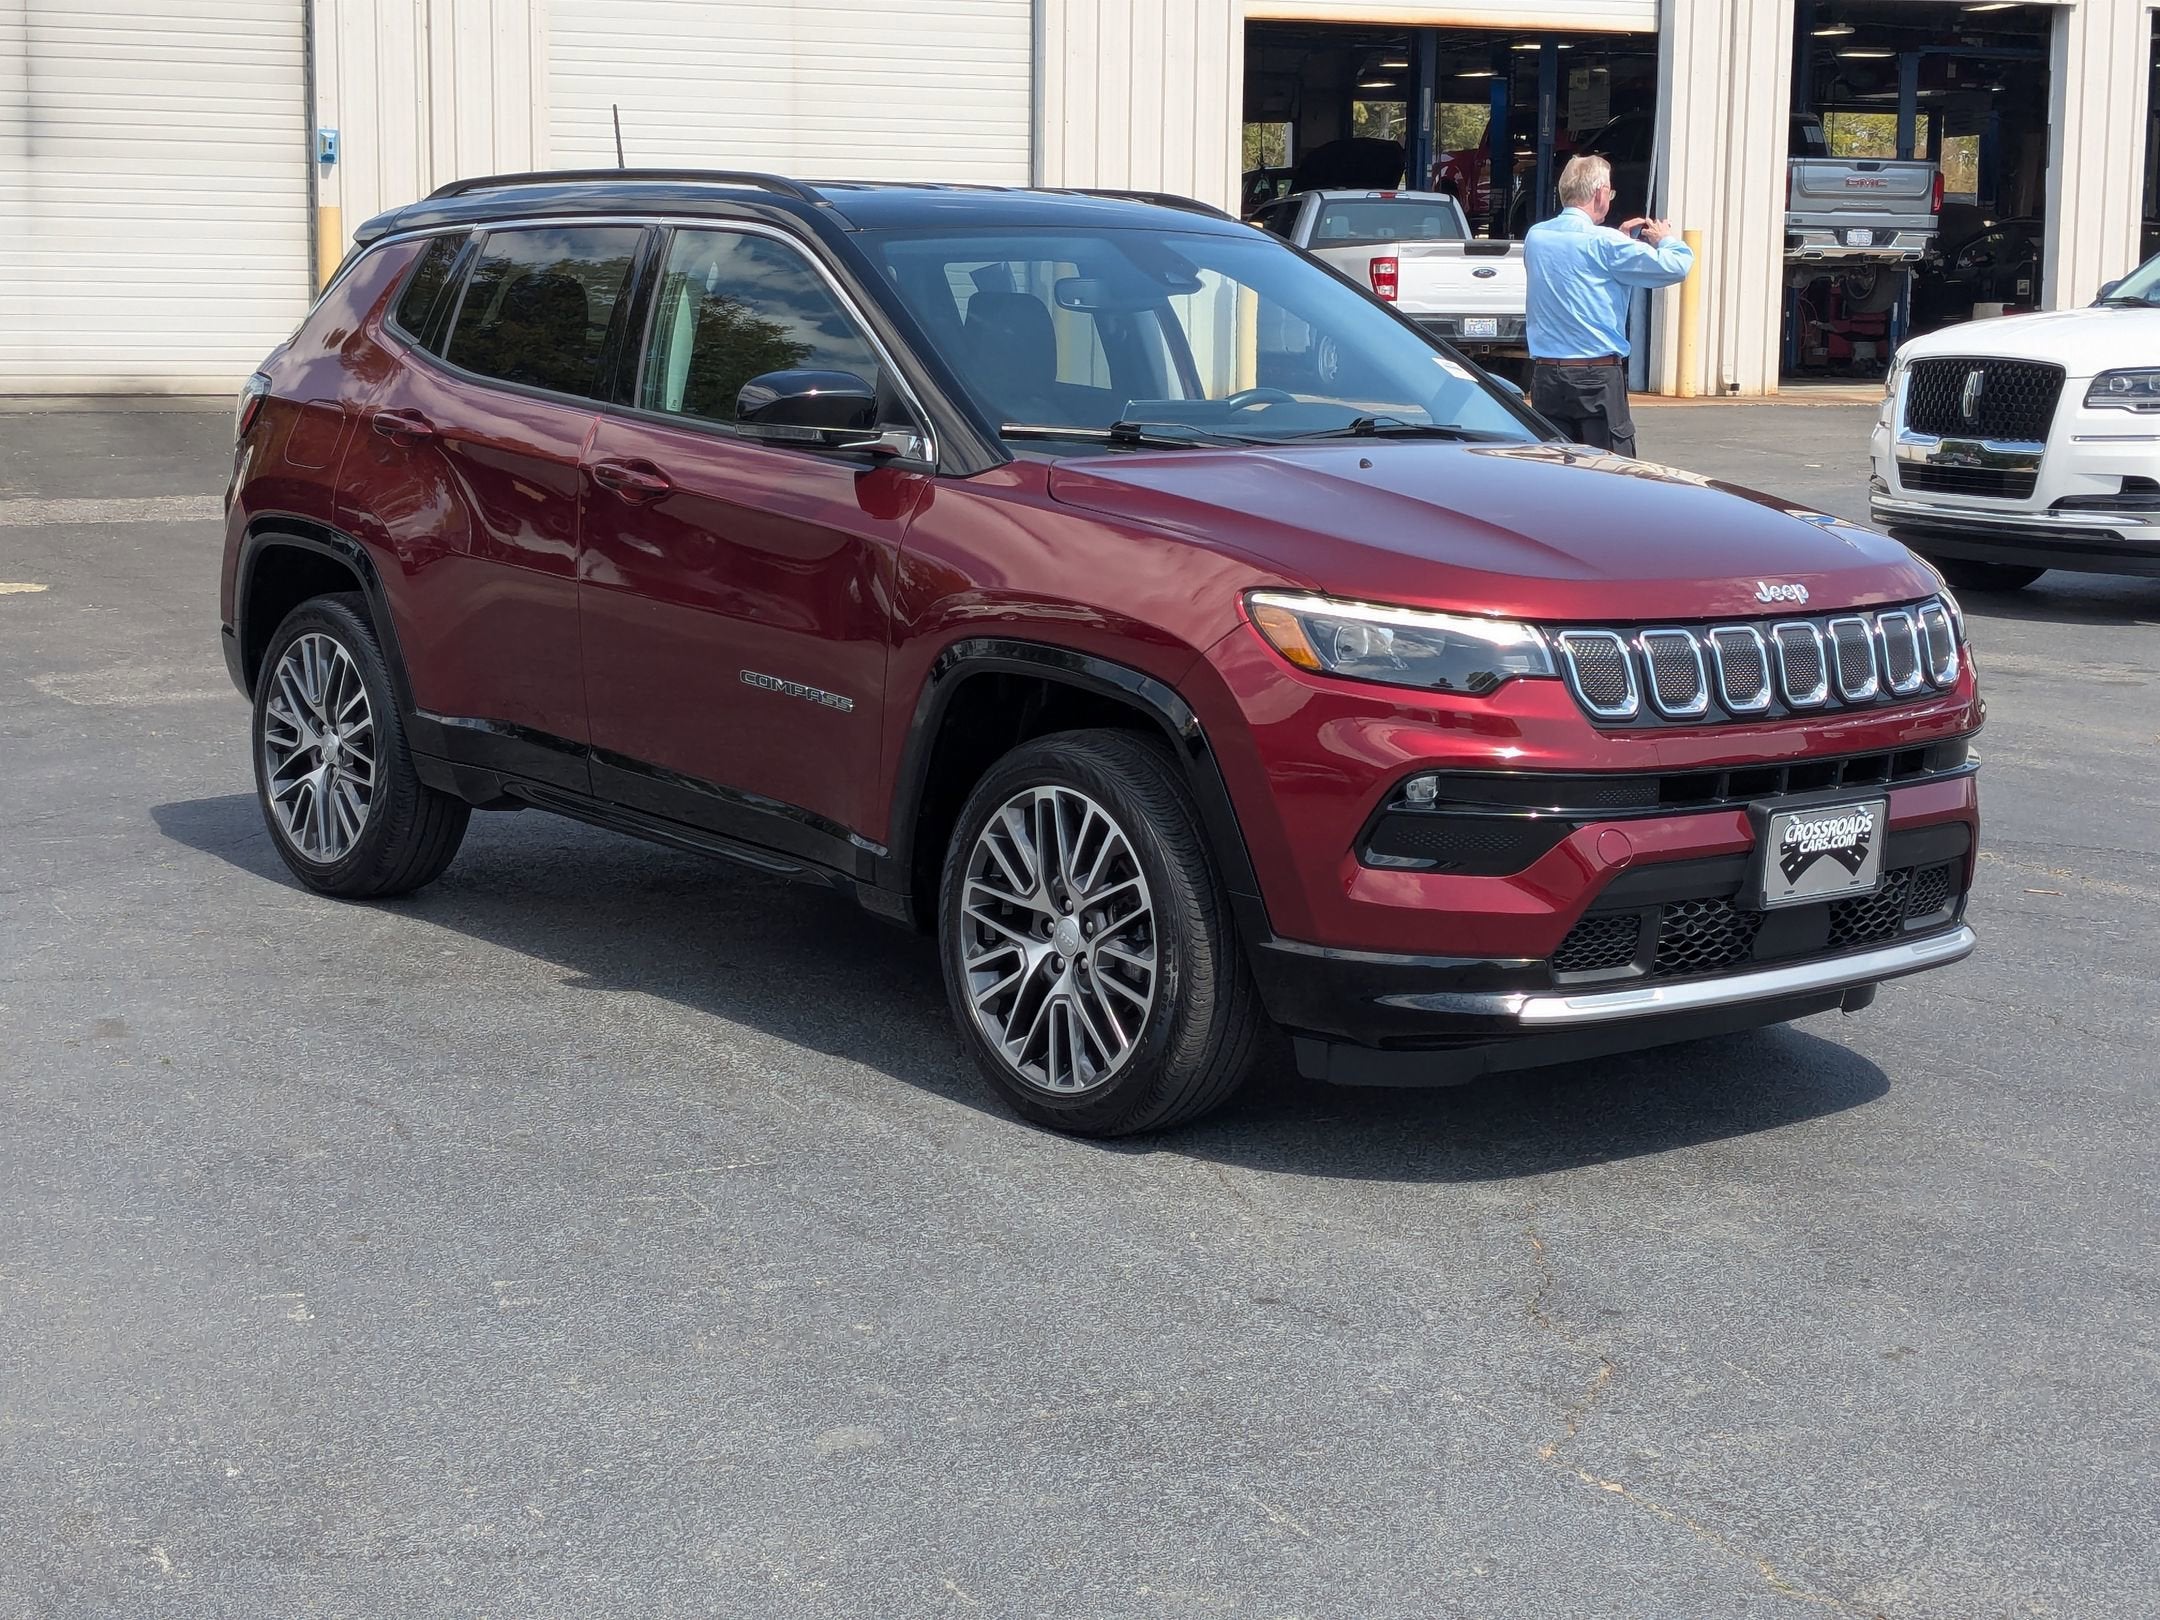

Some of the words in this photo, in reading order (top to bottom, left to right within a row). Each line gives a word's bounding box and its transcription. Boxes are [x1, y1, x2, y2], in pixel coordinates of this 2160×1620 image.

[1845, 176, 1889, 187] GMC
[1755, 581, 1809, 605] Jeep
[739, 669, 854, 712] COMPASS
[1784, 813, 1874, 843] CROSSROADS
[1799, 833, 1858, 853] CARS.COM
